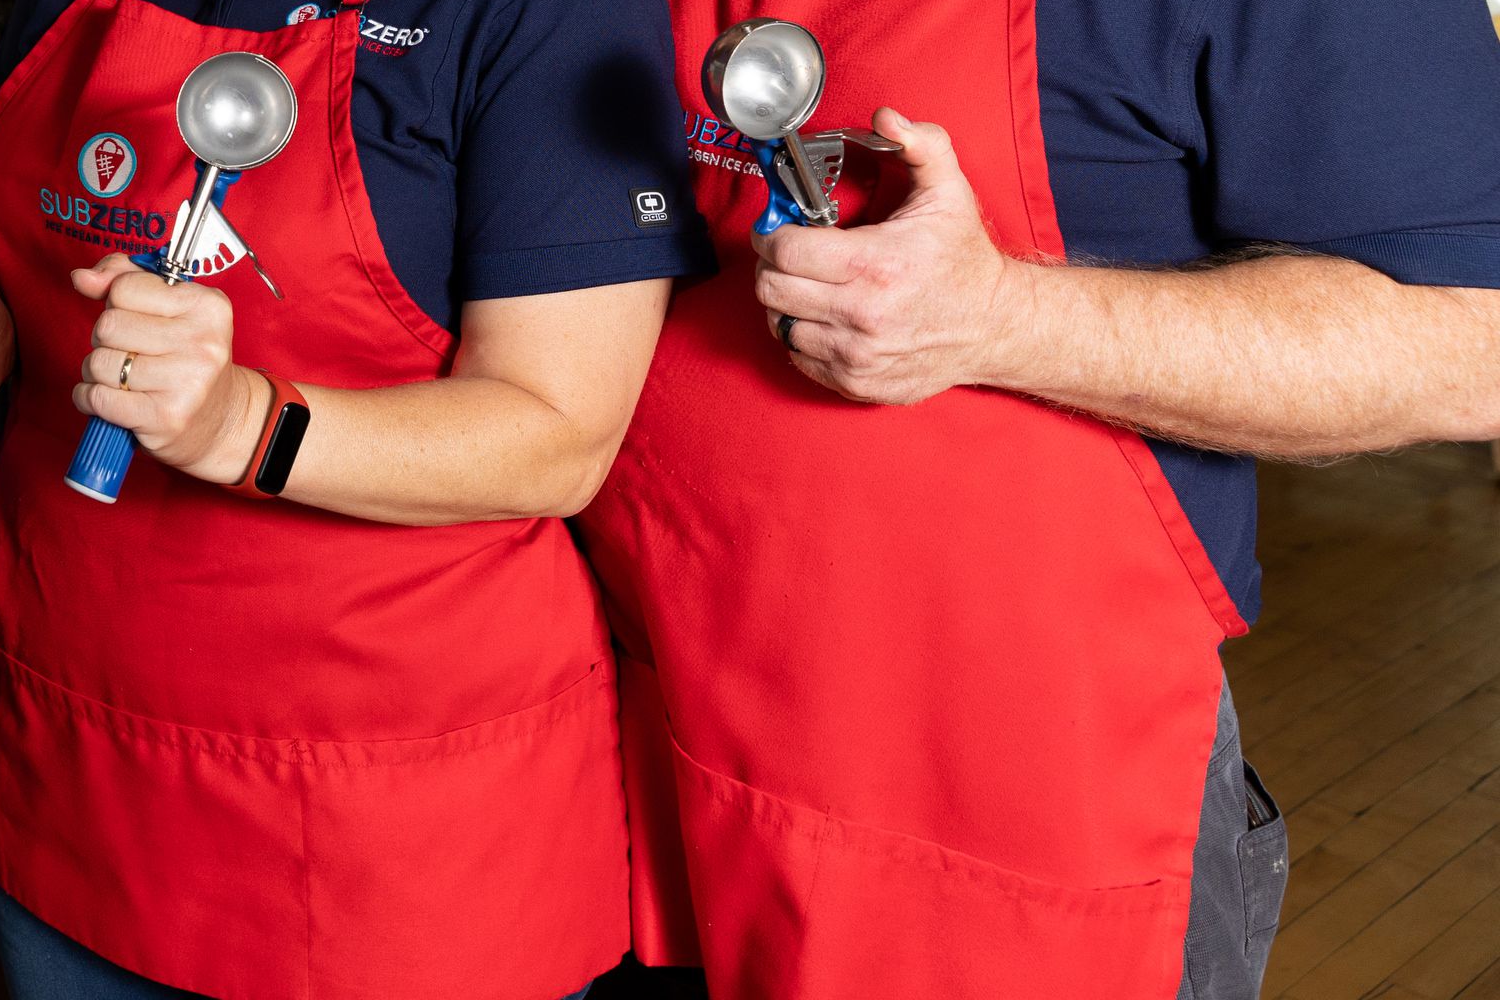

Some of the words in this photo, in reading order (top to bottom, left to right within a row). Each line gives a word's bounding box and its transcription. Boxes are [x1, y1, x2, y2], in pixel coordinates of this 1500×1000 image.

[721, 156, 742, 172] ICE
[743, 163, 764, 178] CRE
[39, 187, 167, 241] SUBZERO
[65, 225, 100, 245] CREAM
